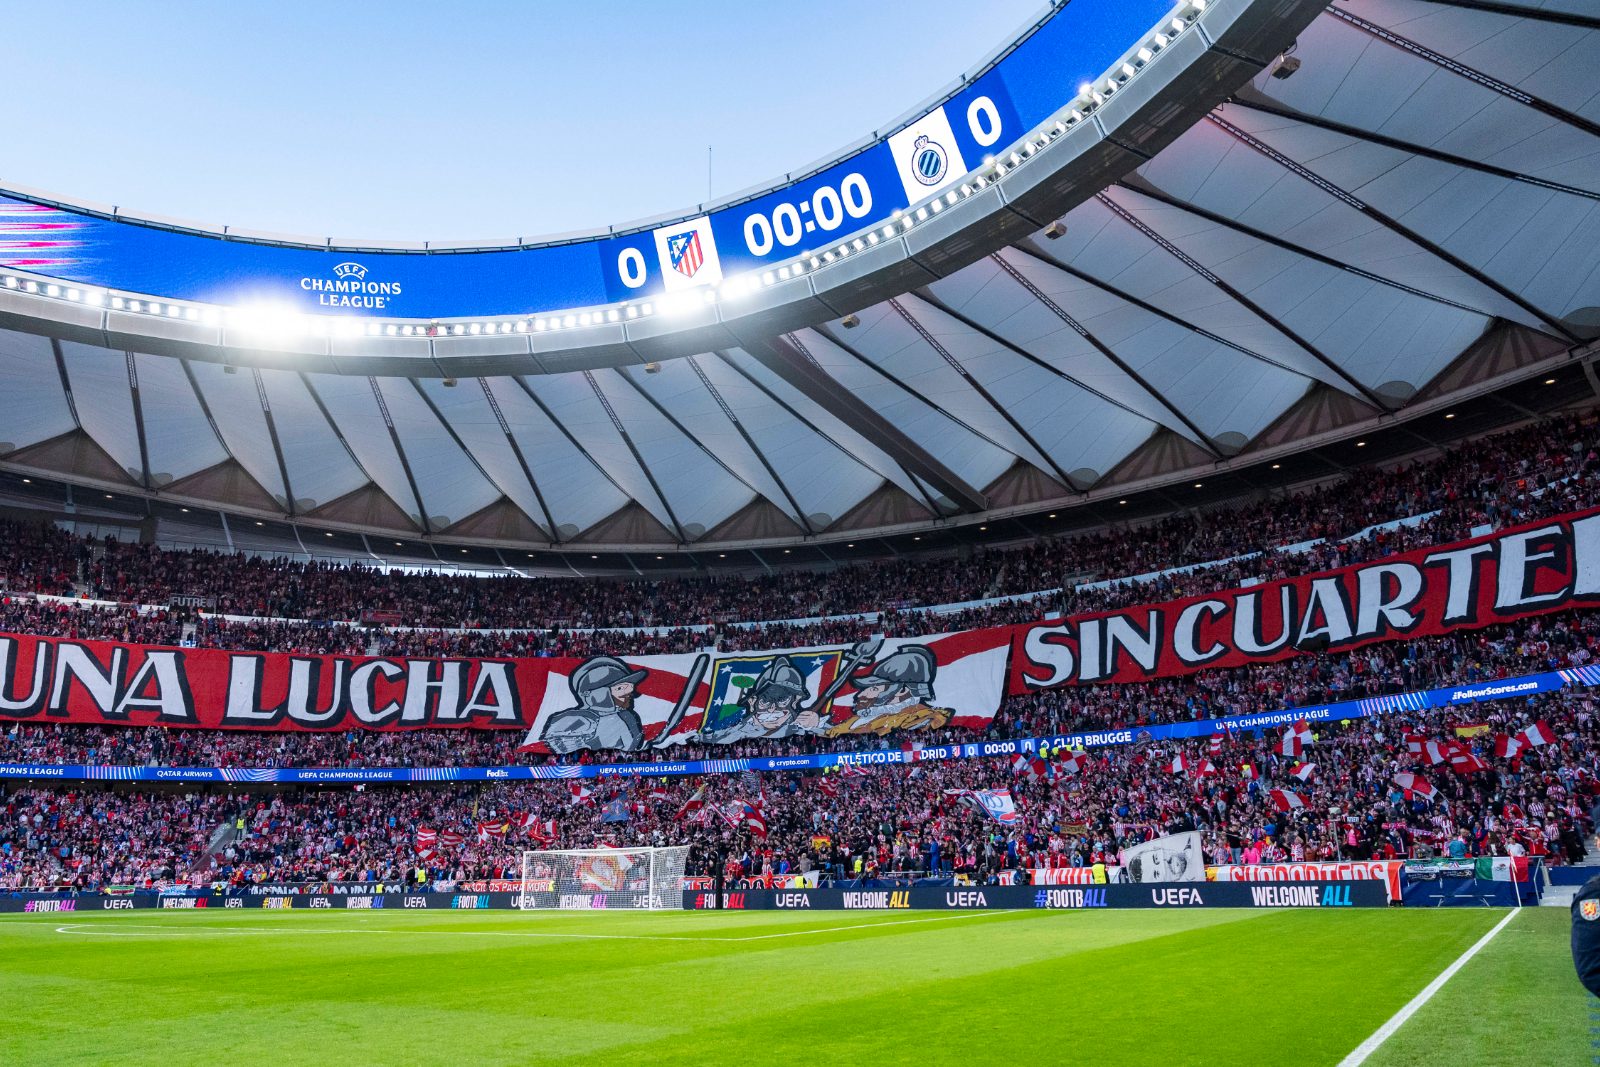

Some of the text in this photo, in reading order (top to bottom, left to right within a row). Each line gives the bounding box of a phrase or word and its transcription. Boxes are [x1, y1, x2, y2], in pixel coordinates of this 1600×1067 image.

[966, 95, 1003, 149] 0
[743, 172, 873, 258] 00:00
[334, 263, 367, 279] UEFA
[616, 248, 647, 289] 0
[300, 278, 402, 295] CHAMPIONS
[319, 293, 386, 309] LEAGUE
[172, 596, 206, 608] FUTRE
[1022, 606, 1166, 690] SIN
[0, 637, 527, 727] UNA LUCHA
[1239, 713, 1292, 727] CHAMPIONS
[1293, 709, 1330, 721] LEAGUE
[887, 751, 902, 763] DE
[917, 748, 947, 761] DRID
[967, 746, 975, 756] 0
[984, 742, 1016, 754] 00:00
[1084, 731, 1132, 746] BRUGGE
[599, 764, 687, 775] UEFA CHAMPIONS LEAGUE
[776, 758, 810, 768] crypto.com
[29, 768, 64, 777] LEAGUE
[156, 770, 181, 778] QATAR
[486, 769, 509, 778] FedEx
[163, 897, 208, 909] WELCOME ALL
[224, 897, 243, 908] UEFA
[262, 896, 293, 908] #FOOTBALL
[310, 897, 329, 908] UEFA
[346, 895, 385, 908] WELCOME ALL
[404, 896, 427, 908] UEFA
[451, 895, 490, 909] #FOOTBALL
[559, 893, 607, 909] WELCOME ALL
[695, 892, 745, 909] #FOBALL
[775, 893, 811, 908] UEFA
[842, 891, 910, 909] WELCOME ALL
[946, 891, 987, 907] UEFA
[1034, 888, 1108, 907] #FOOTBALL
[1151, 888, 1204, 905] UEFA
[1250, 885, 1353, 907] WELCOME ALL
[24, 899, 76, 913] #FOOTBALL
[103, 899, 134, 910] UEFA
